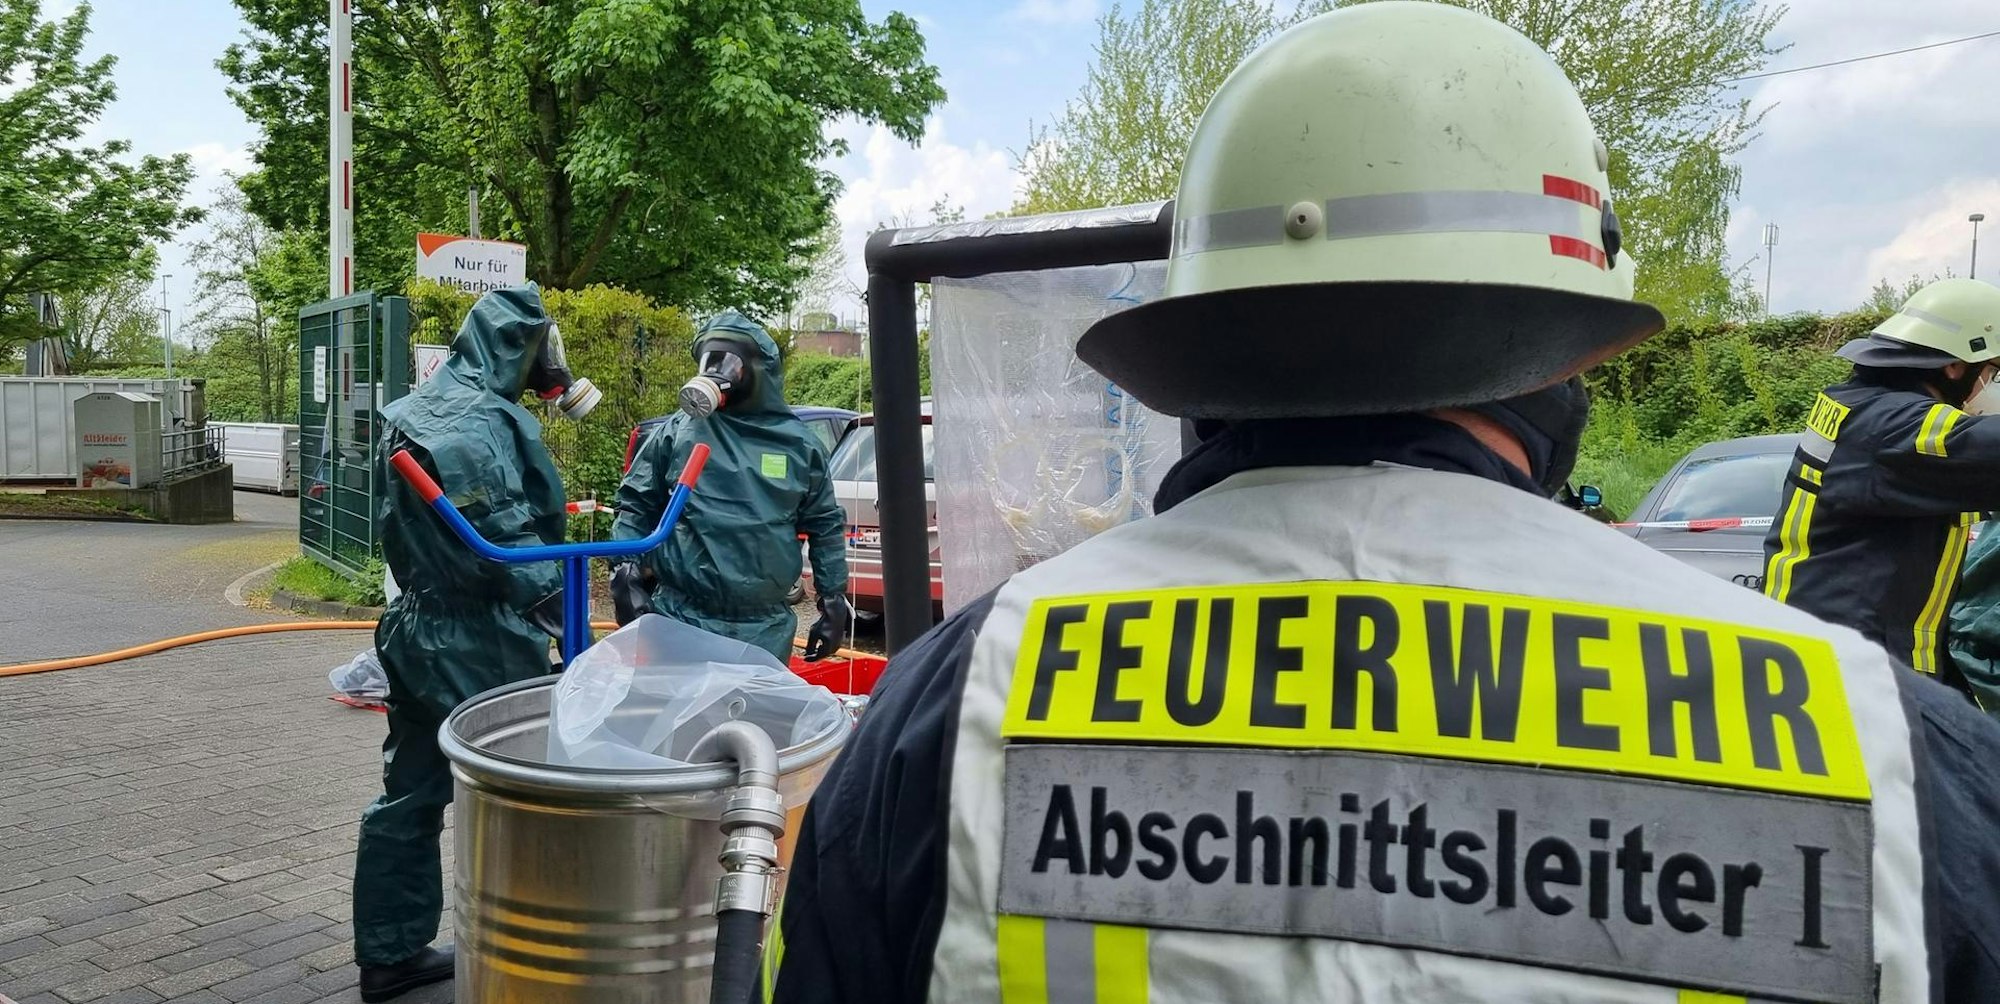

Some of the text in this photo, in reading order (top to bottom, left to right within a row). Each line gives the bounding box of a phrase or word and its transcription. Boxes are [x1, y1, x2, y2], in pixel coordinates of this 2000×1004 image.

[454, 256, 508, 273] Nur für
[1026, 595, 1831, 776] FEUERWEHR
[1031, 783, 1832, 949] Abschnittsleiter I
